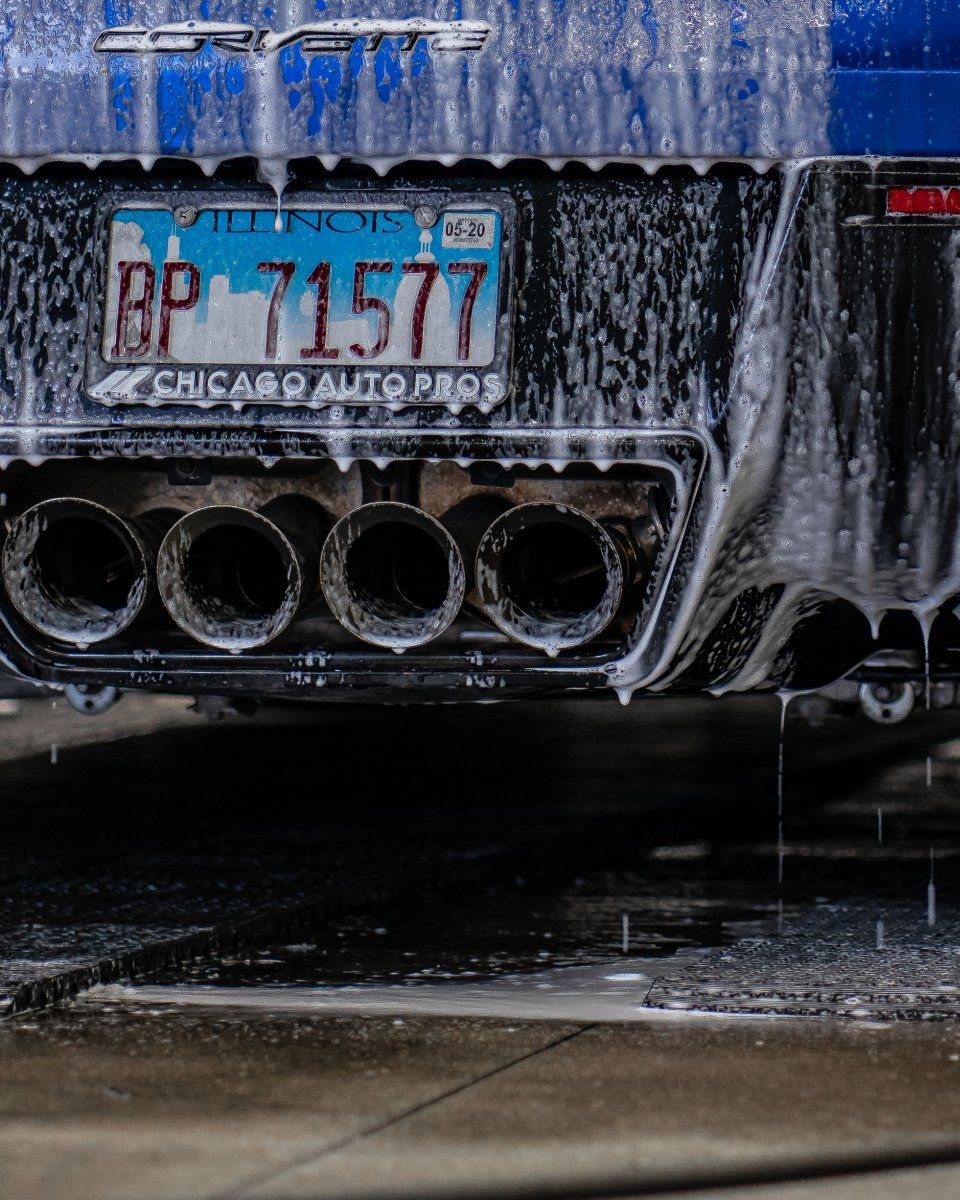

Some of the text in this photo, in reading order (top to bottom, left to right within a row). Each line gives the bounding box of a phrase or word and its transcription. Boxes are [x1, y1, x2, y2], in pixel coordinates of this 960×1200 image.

[445, 221, 486, 237] 05-20
[111, 260, 489, 360] BP 71577
[153, 370, 502, 400] CHICAGO AUTO PROS
